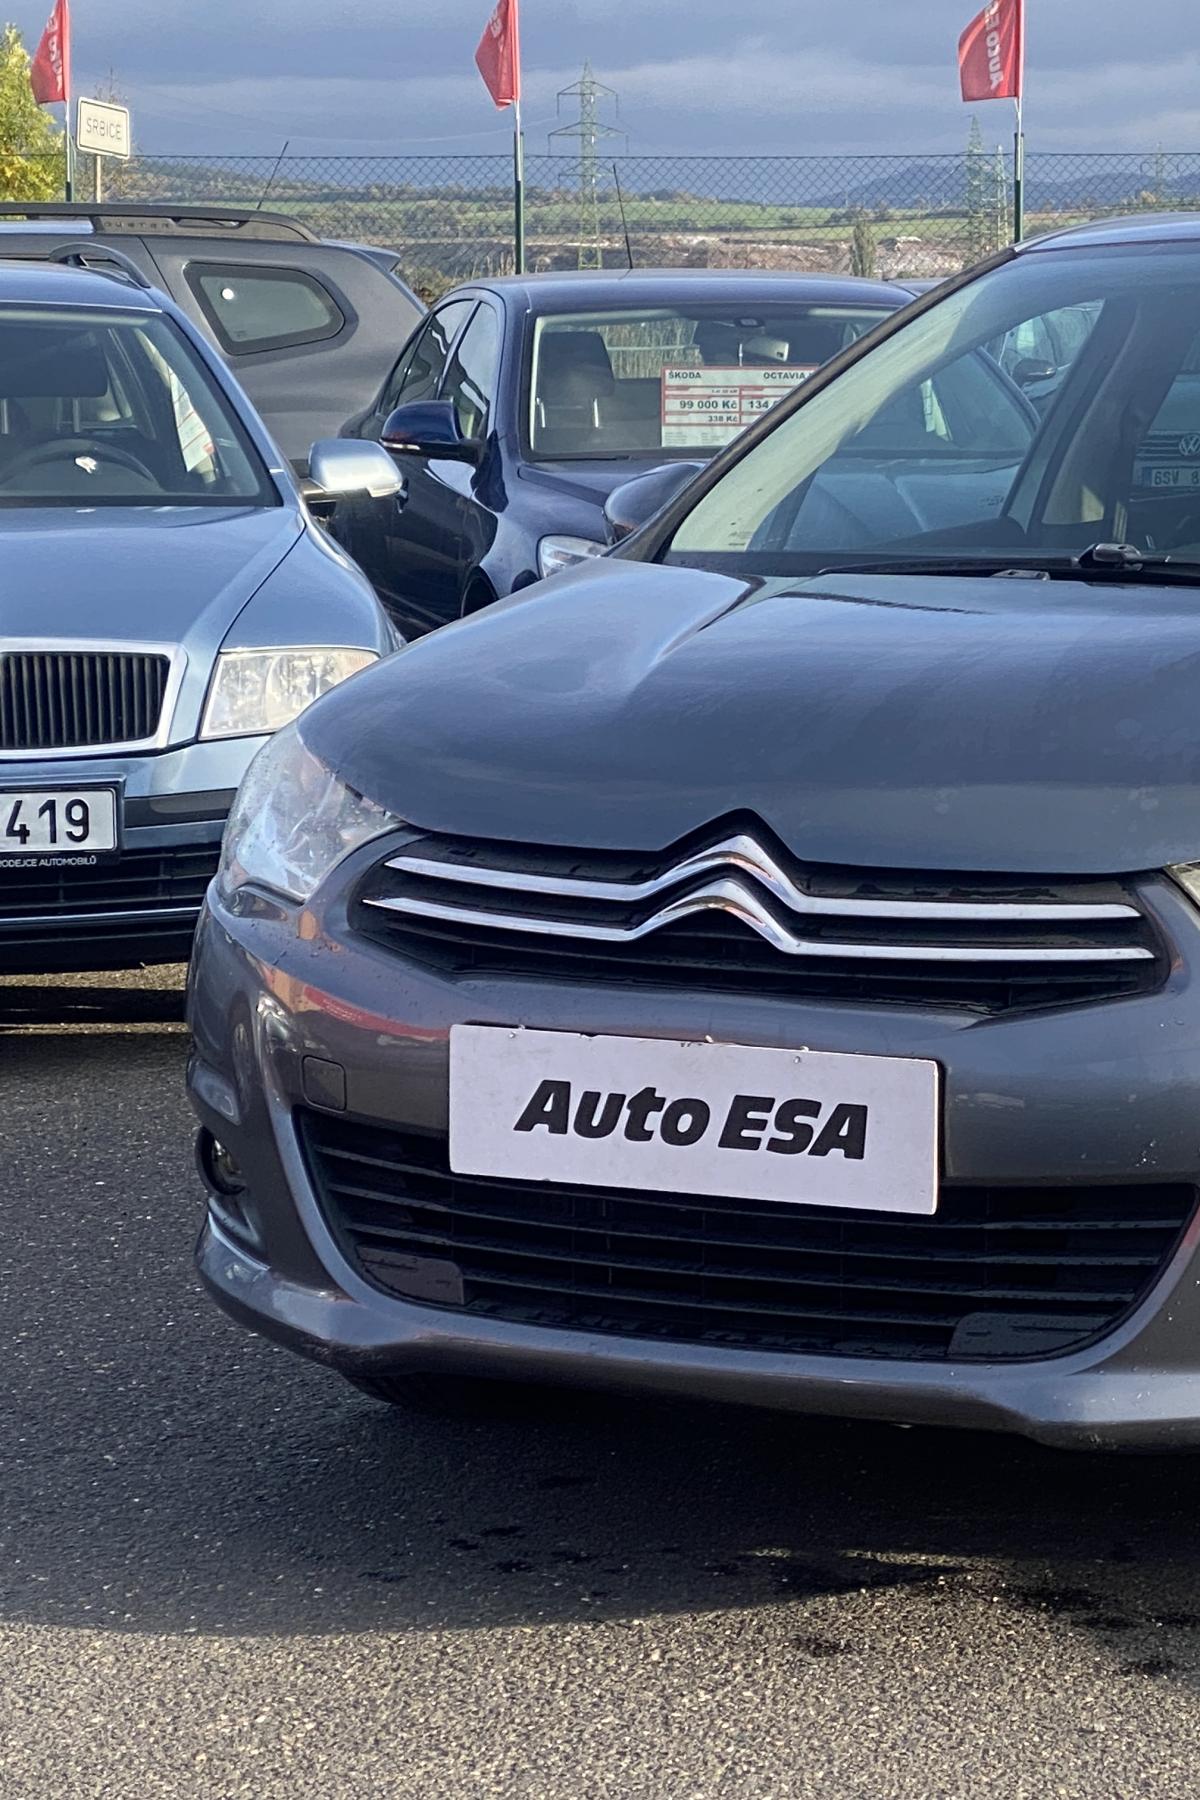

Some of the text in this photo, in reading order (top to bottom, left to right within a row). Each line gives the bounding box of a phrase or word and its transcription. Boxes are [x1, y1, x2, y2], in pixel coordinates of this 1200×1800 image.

[86, 117, 122, 140] SRBICE
[668, 371, 806, 380] ŠKODA OCTAVIA
[680, 400, 737, 409] 99 000 Kč
[748, 401, 769, 409] 134
[6, 798, 90, 845] 419
[39, 855, 97, 867] AUTOMOBILŮ
[513, 1079, 868, 1160] Auto ESA
